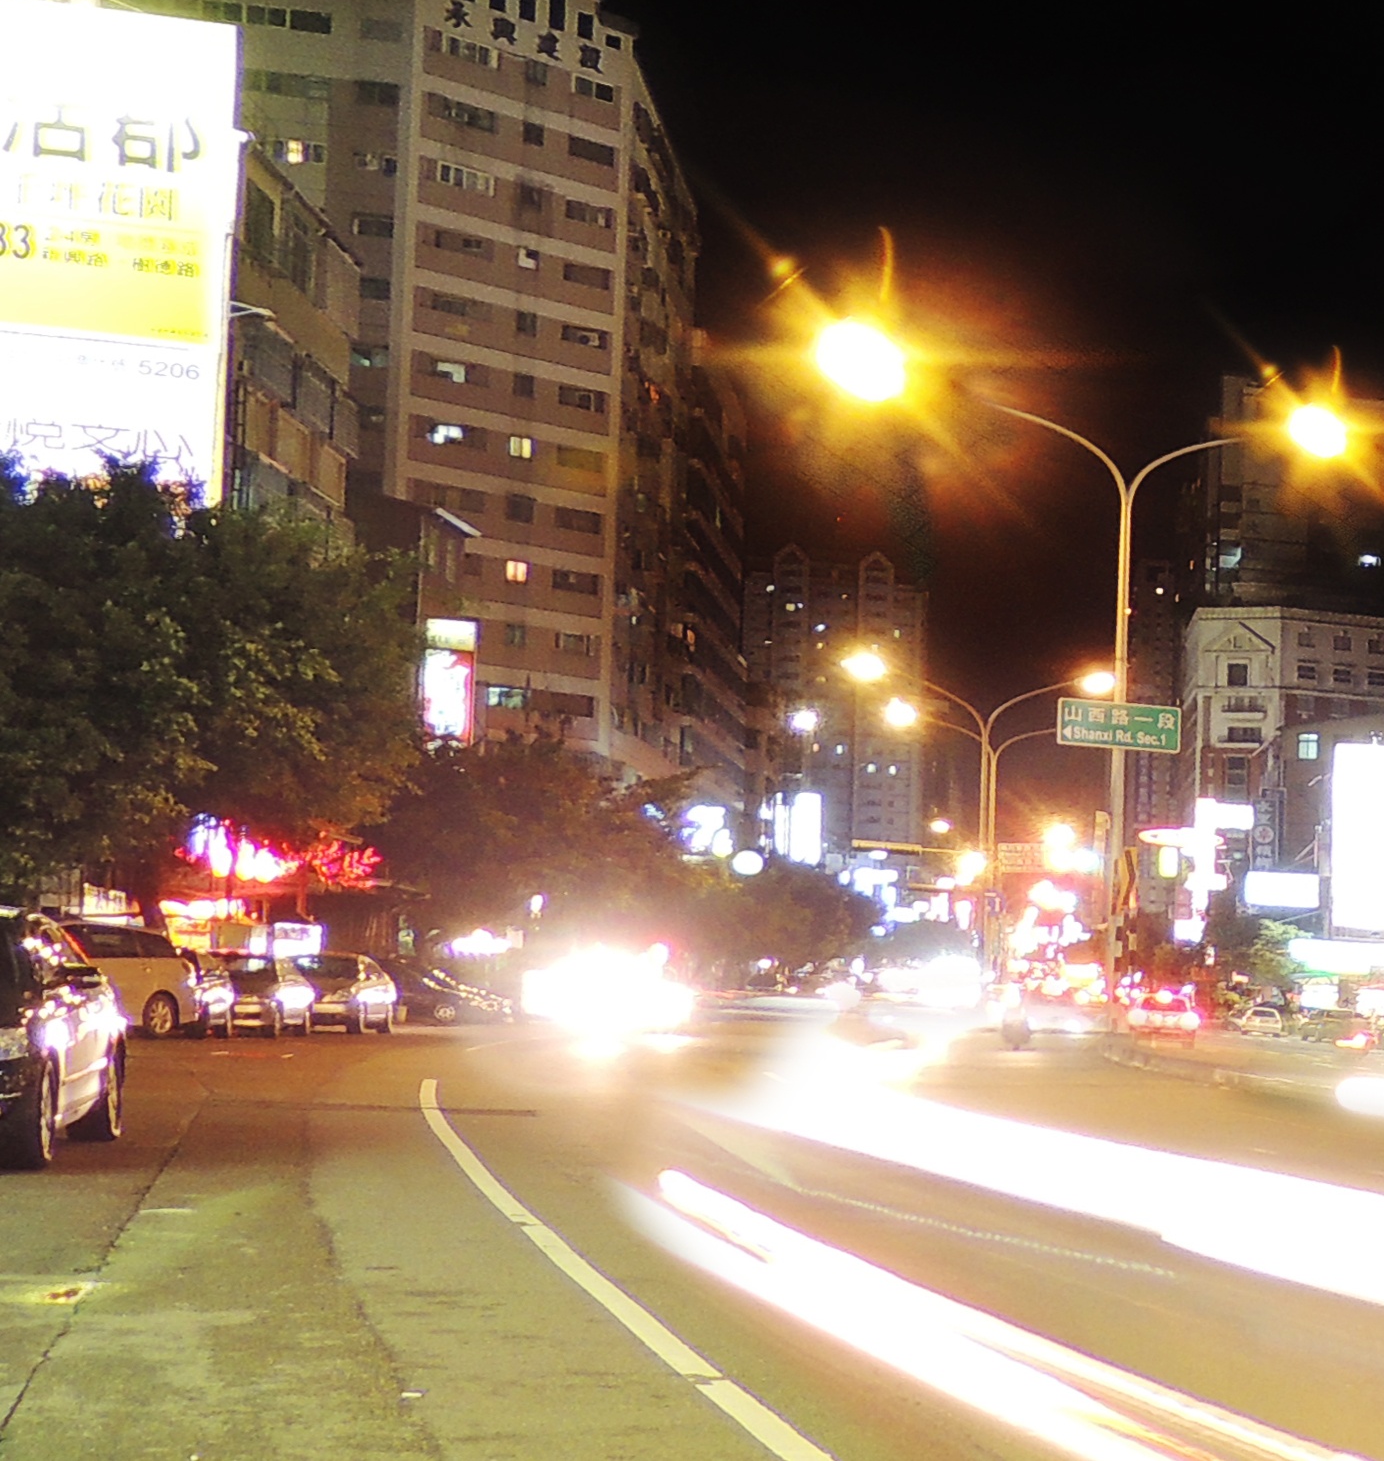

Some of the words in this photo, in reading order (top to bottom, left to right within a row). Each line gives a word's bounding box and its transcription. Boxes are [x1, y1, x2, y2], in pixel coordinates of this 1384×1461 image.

[138, 359, 201, 381] 5206
[1063, 704, 1176, 731] 山西路一段
[1073, 725, 1113, 741] Shanxi
[1115, 729, 1134, 743] Rd.
